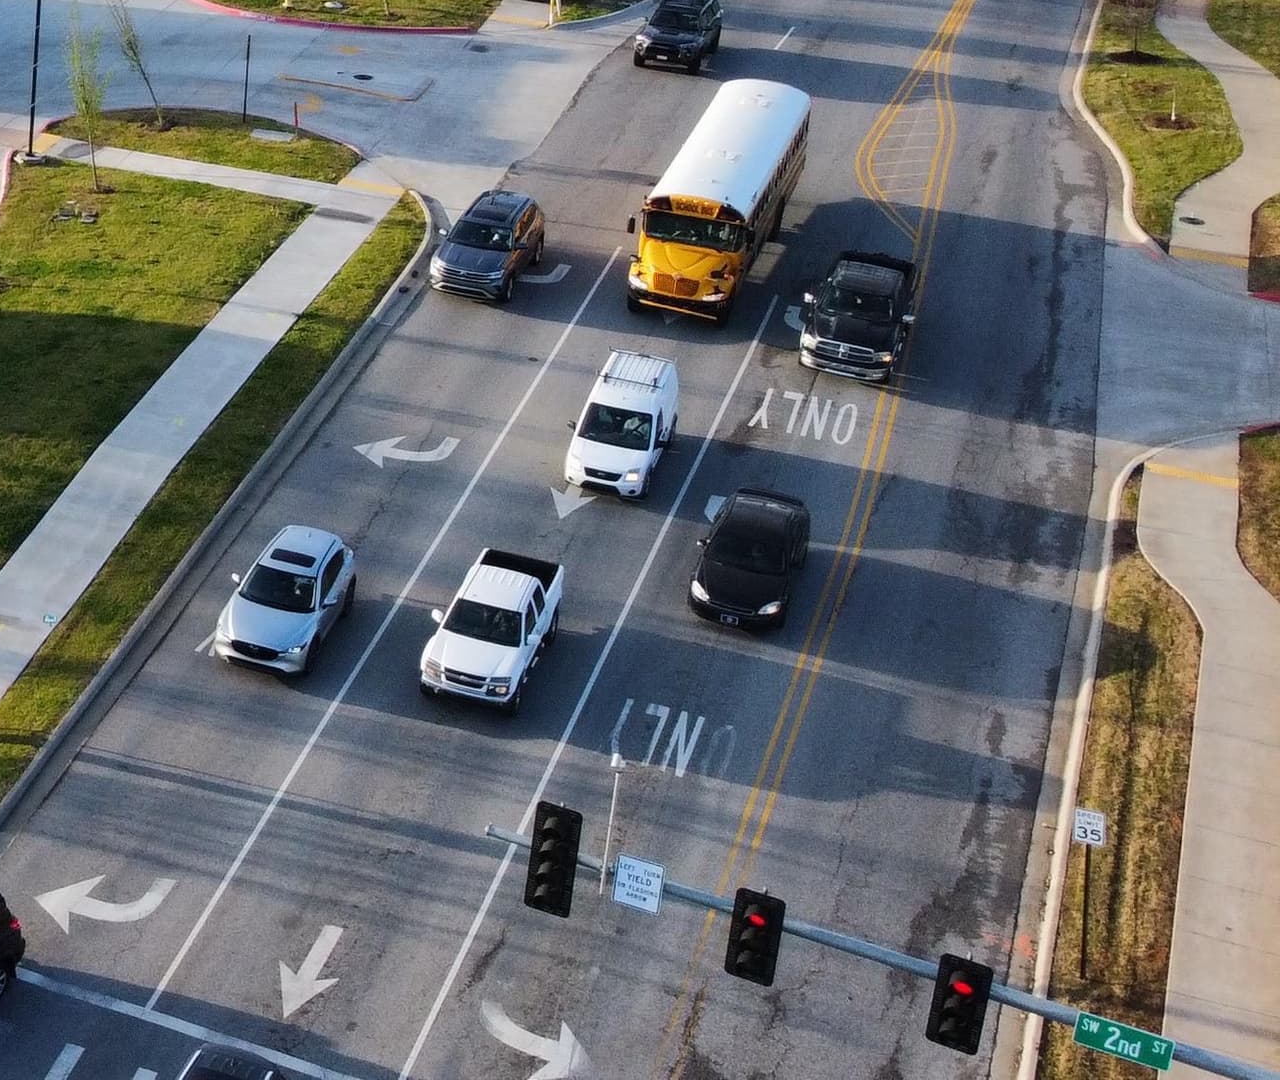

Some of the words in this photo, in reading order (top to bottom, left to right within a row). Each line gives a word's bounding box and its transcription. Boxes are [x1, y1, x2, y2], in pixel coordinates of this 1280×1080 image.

[675, 201, 699, 213] SCHOOL
[747, 388, 858, 445] ONLY
[1077, 810, 1103, 821] SPEED
[1076, 825, 1102, 842] 35
[620, 862, 635, 871] LEFT
[627, 872, 652, 887] YIELD
[1081, 1018, 1100, 1034] SW
[1103, 1026, 1142, 1059] 2nd
[1152, 1040, 1168, 1055] ST
